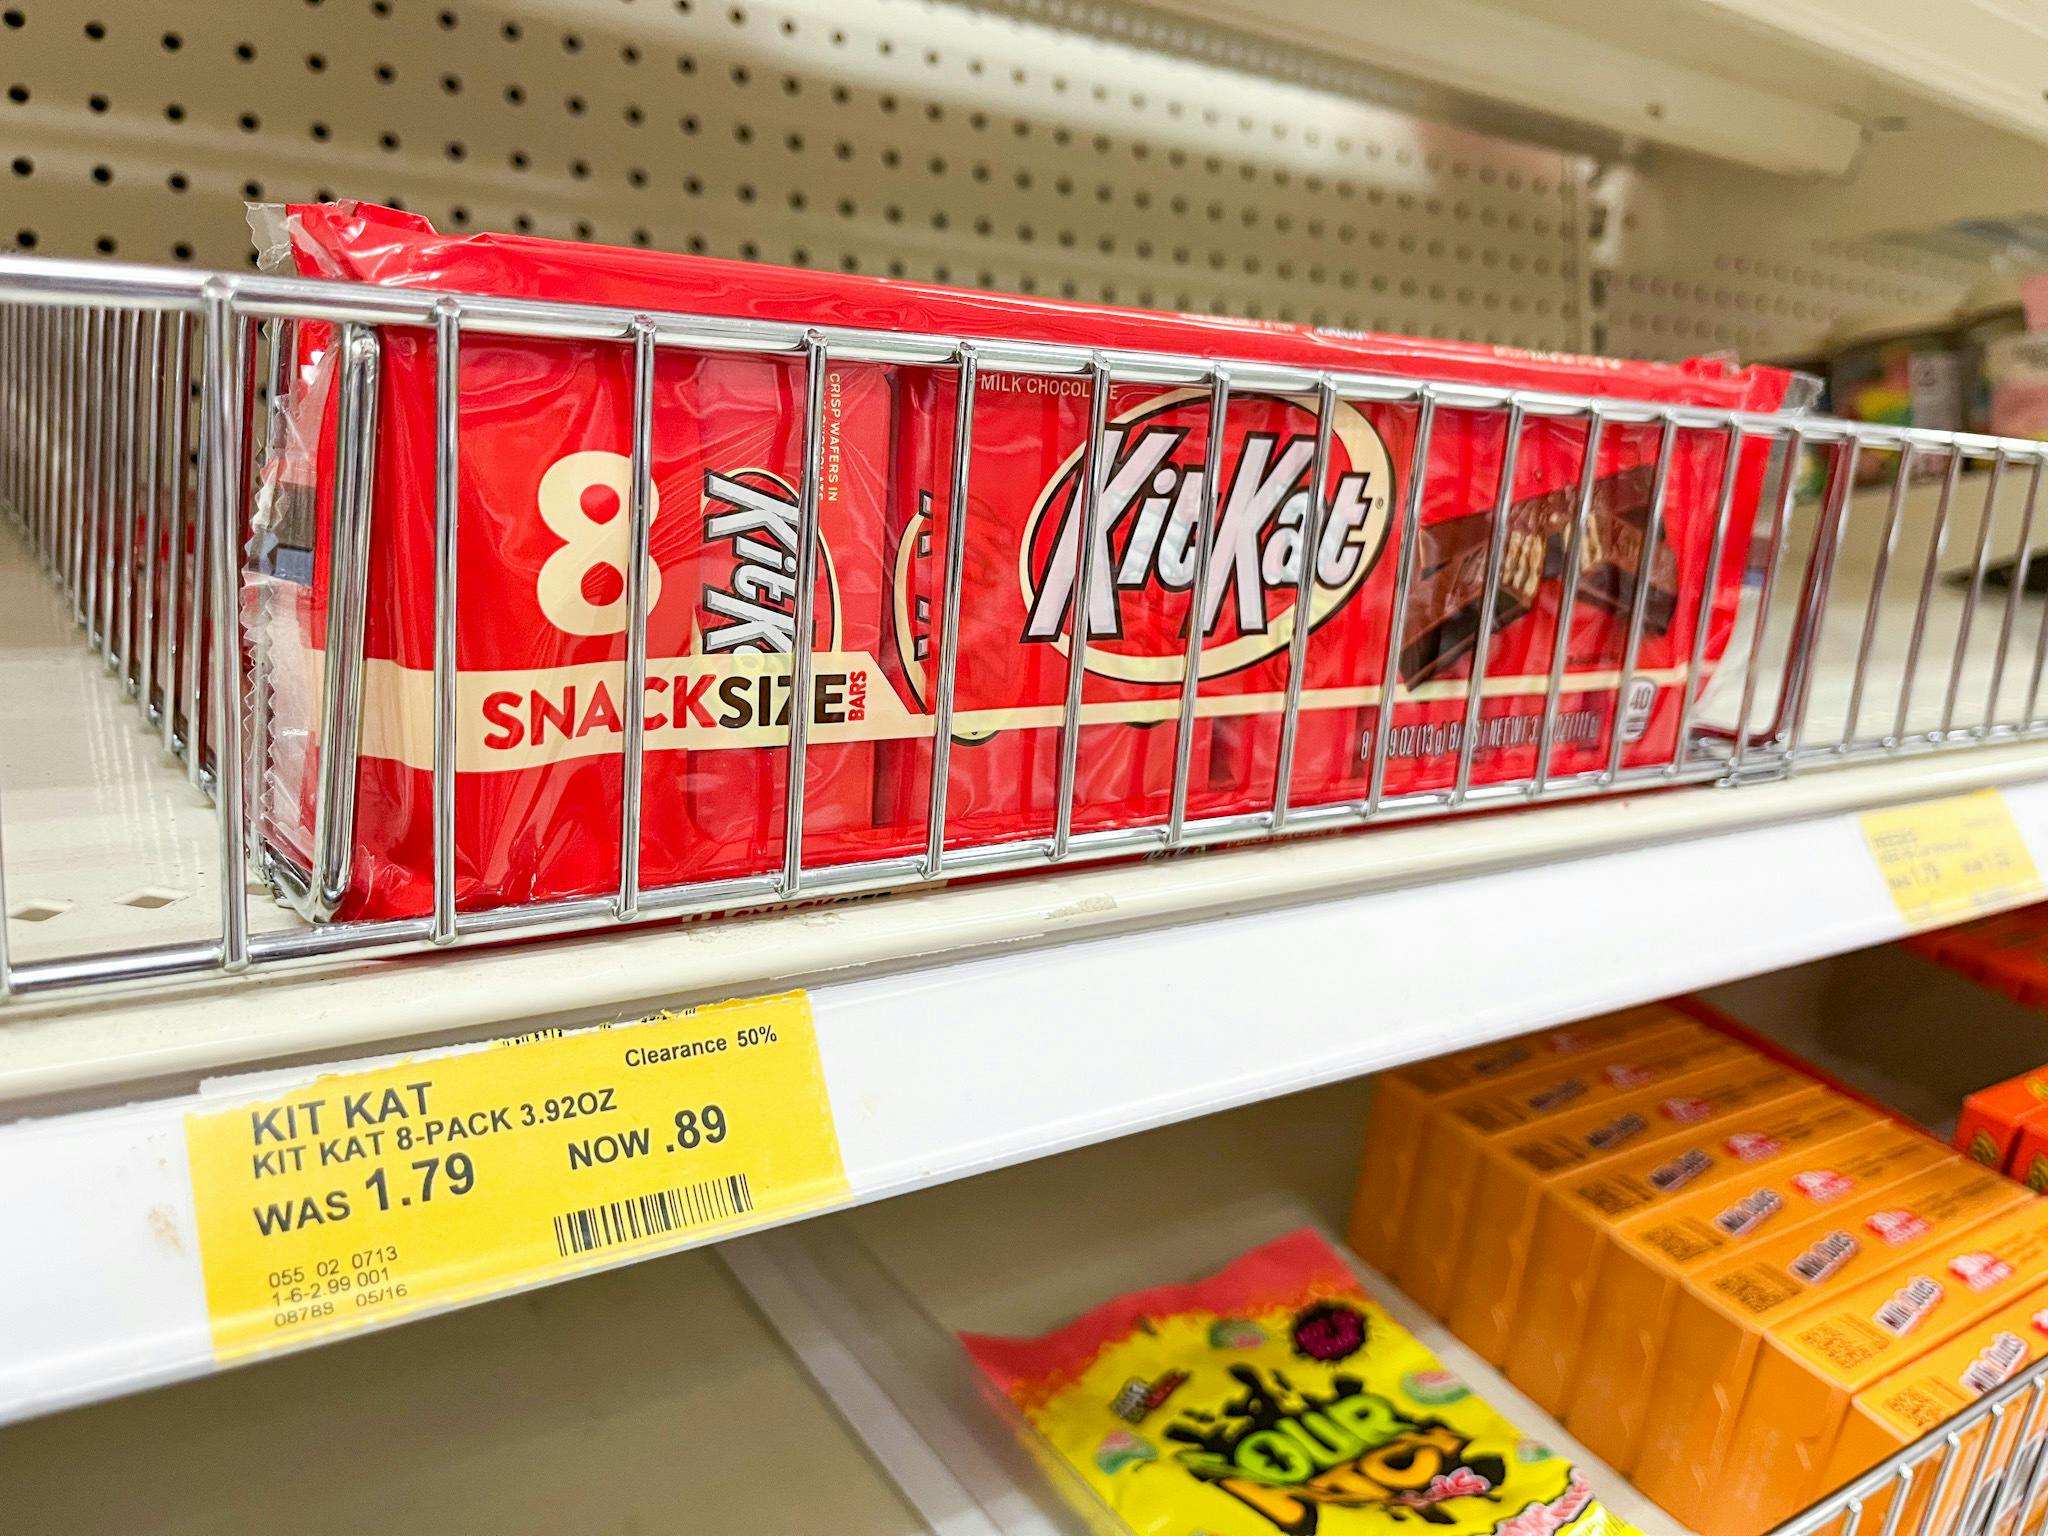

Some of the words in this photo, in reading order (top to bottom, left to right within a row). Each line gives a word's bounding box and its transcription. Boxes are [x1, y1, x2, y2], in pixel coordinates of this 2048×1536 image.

[830, 373, 841, 418] CRISP
[980, 374, 1022, 393] MILK
[1027, 378, 1118, 400] CHOCOLE
[828, 422, 841, 483] WAFERS
[828, 487, 839, 502] IN
[537, 451, 662, 637] 8
[848, 670, 868, 722] BARS
[625, 1034, 728, 1067] Clearance
[737, 1024, 778, 1047] 50%
[251, 1099, 328, 1146] KIT
[344, 1081, 434, 1129] KAT
[252, 1146, 307, 1179] KIT
[319, 1130, 386, 1166] KAT
[396, 1108, 513, 1151] 8-PACK
[519, 1088, 618, 1127] 3.92OZ
[567, 1128, 651, 1170] NOW
[664, 1104, 728, 1154] .89
[253, 1190, 351, 1237] WAS
[364, 1152, 475, 1211] 1.79
[268, 1267, 305, 1288] 055
[316, 1258, 340, 1277] 02
[351, 1245, 398, 1269] 0713
[356, 1266, 390, 1288] 001
[355, 1283, 408, 1308] 05/16
